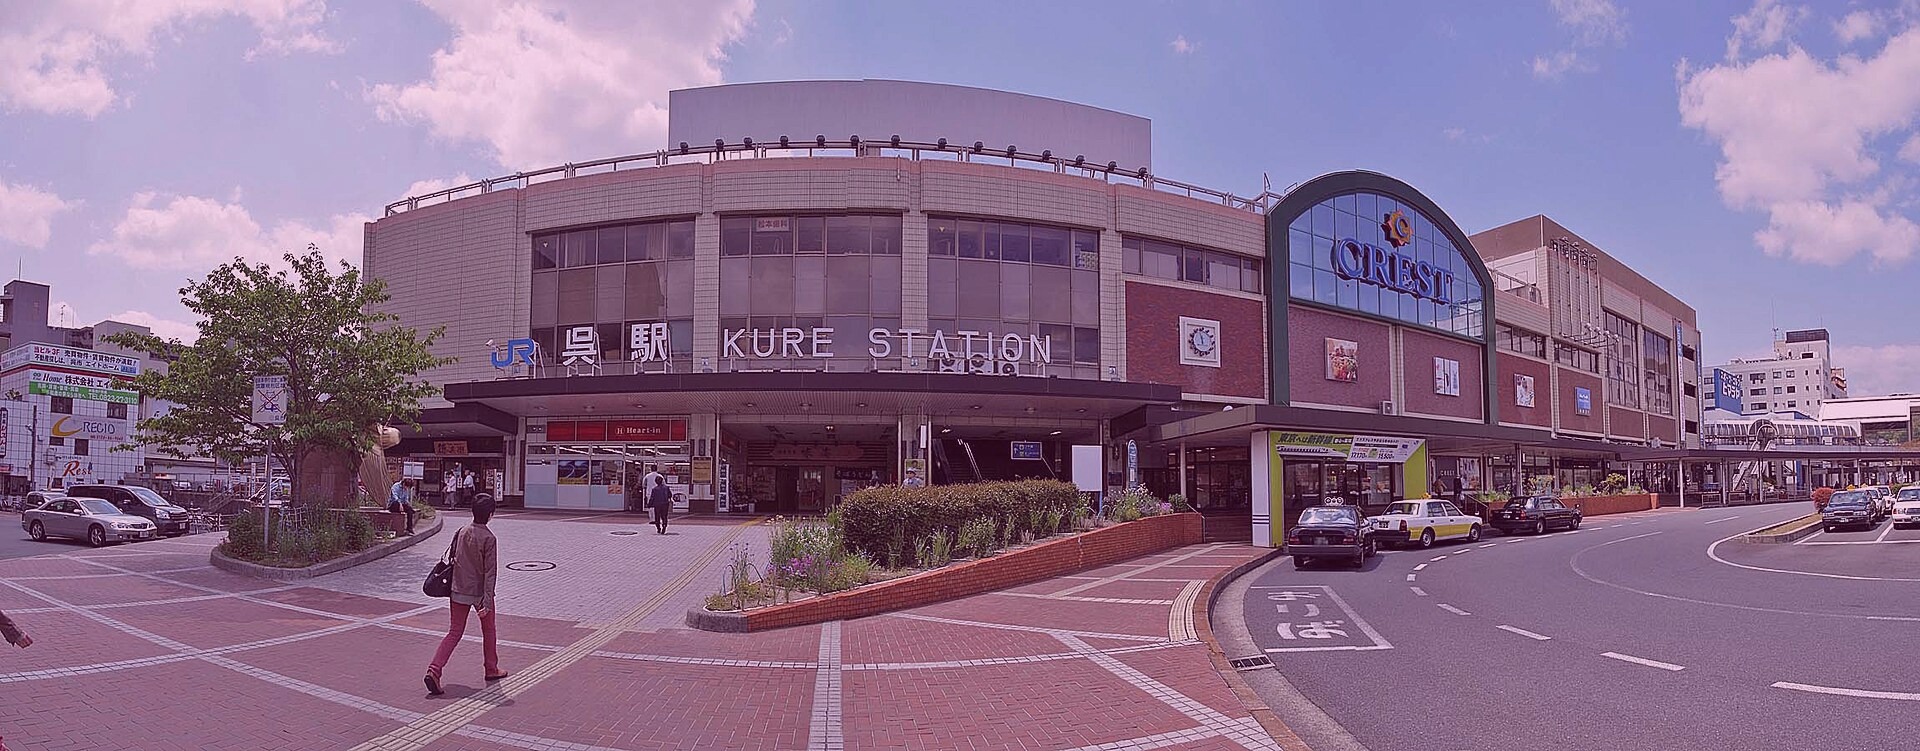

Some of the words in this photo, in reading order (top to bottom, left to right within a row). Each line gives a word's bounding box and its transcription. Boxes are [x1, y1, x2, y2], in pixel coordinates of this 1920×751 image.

[1335, 238, 1455, 302] CREST
[491, 338, 535, 367] JR
[722, 328, 836, 359] KURE
[868, 328, 1052, 364] STATION
[65, 376, 94, 387] 株式会社
